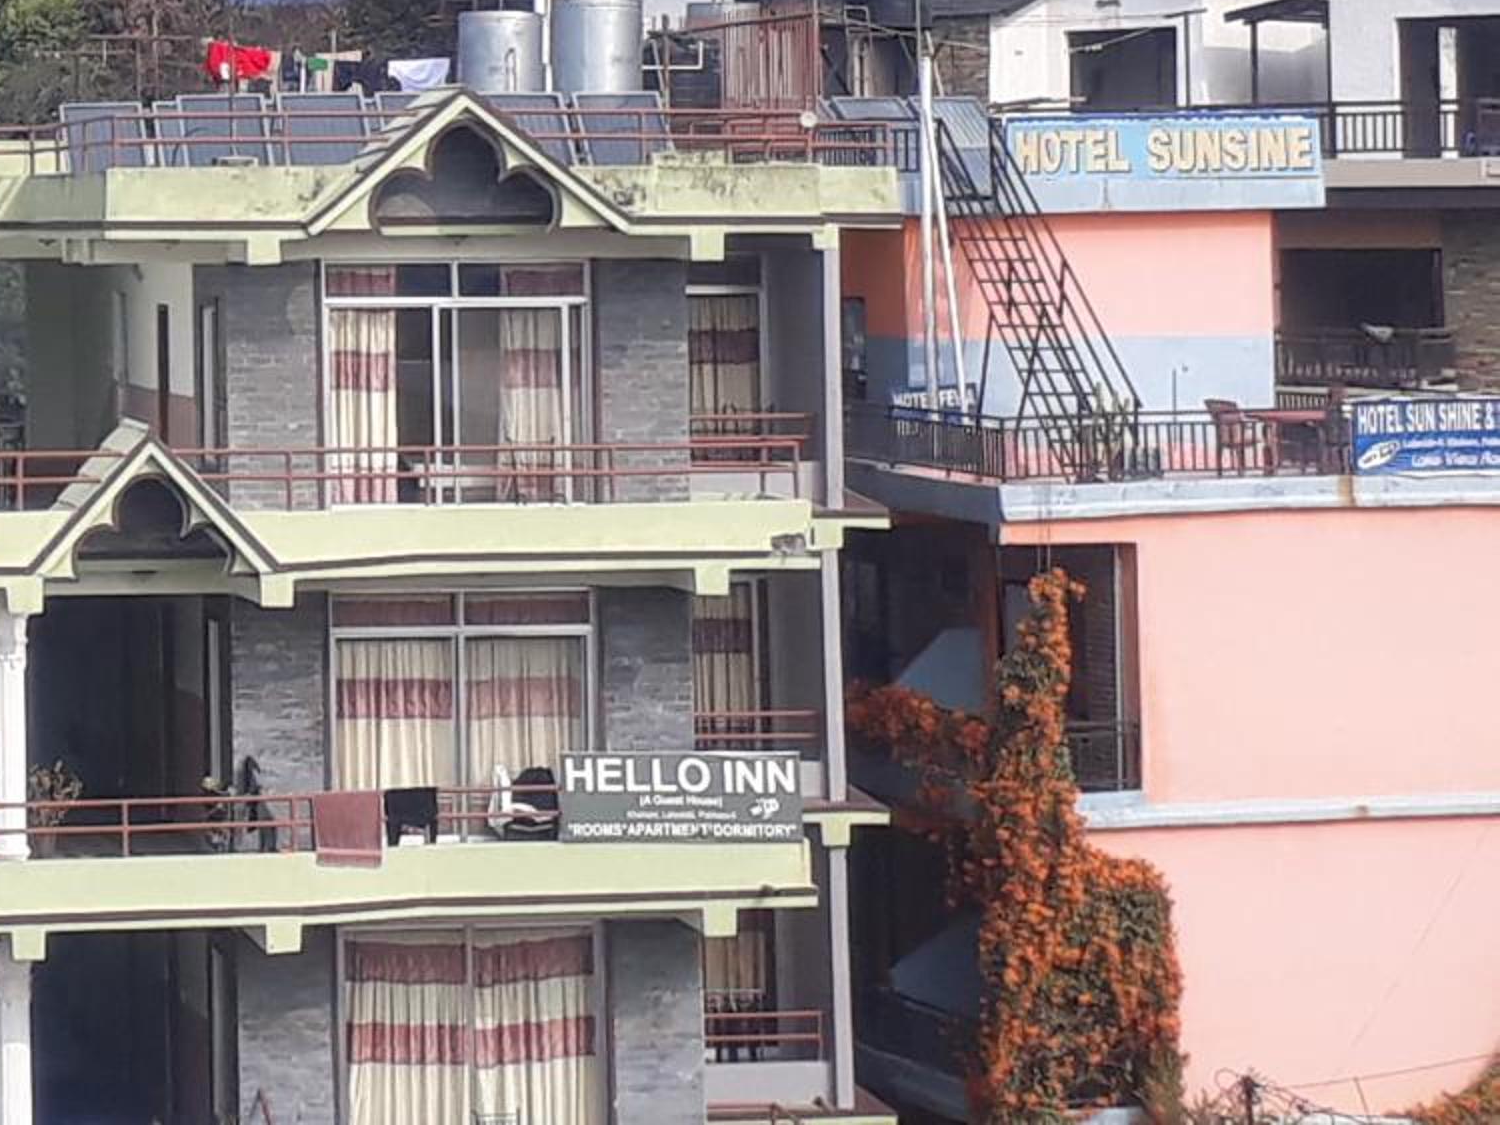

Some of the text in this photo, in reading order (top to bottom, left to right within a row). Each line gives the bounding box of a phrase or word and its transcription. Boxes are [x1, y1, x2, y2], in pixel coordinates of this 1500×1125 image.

[1013, 127, 1316, 174] HOTEL SUNSINE
[1357, 403, 1404, 435] HOTEL
[1405, 402, 1436, 433] SUN
[1438, 402, 1482, 432] SHINE
[564, 757, 797, 794] HELLO INN
